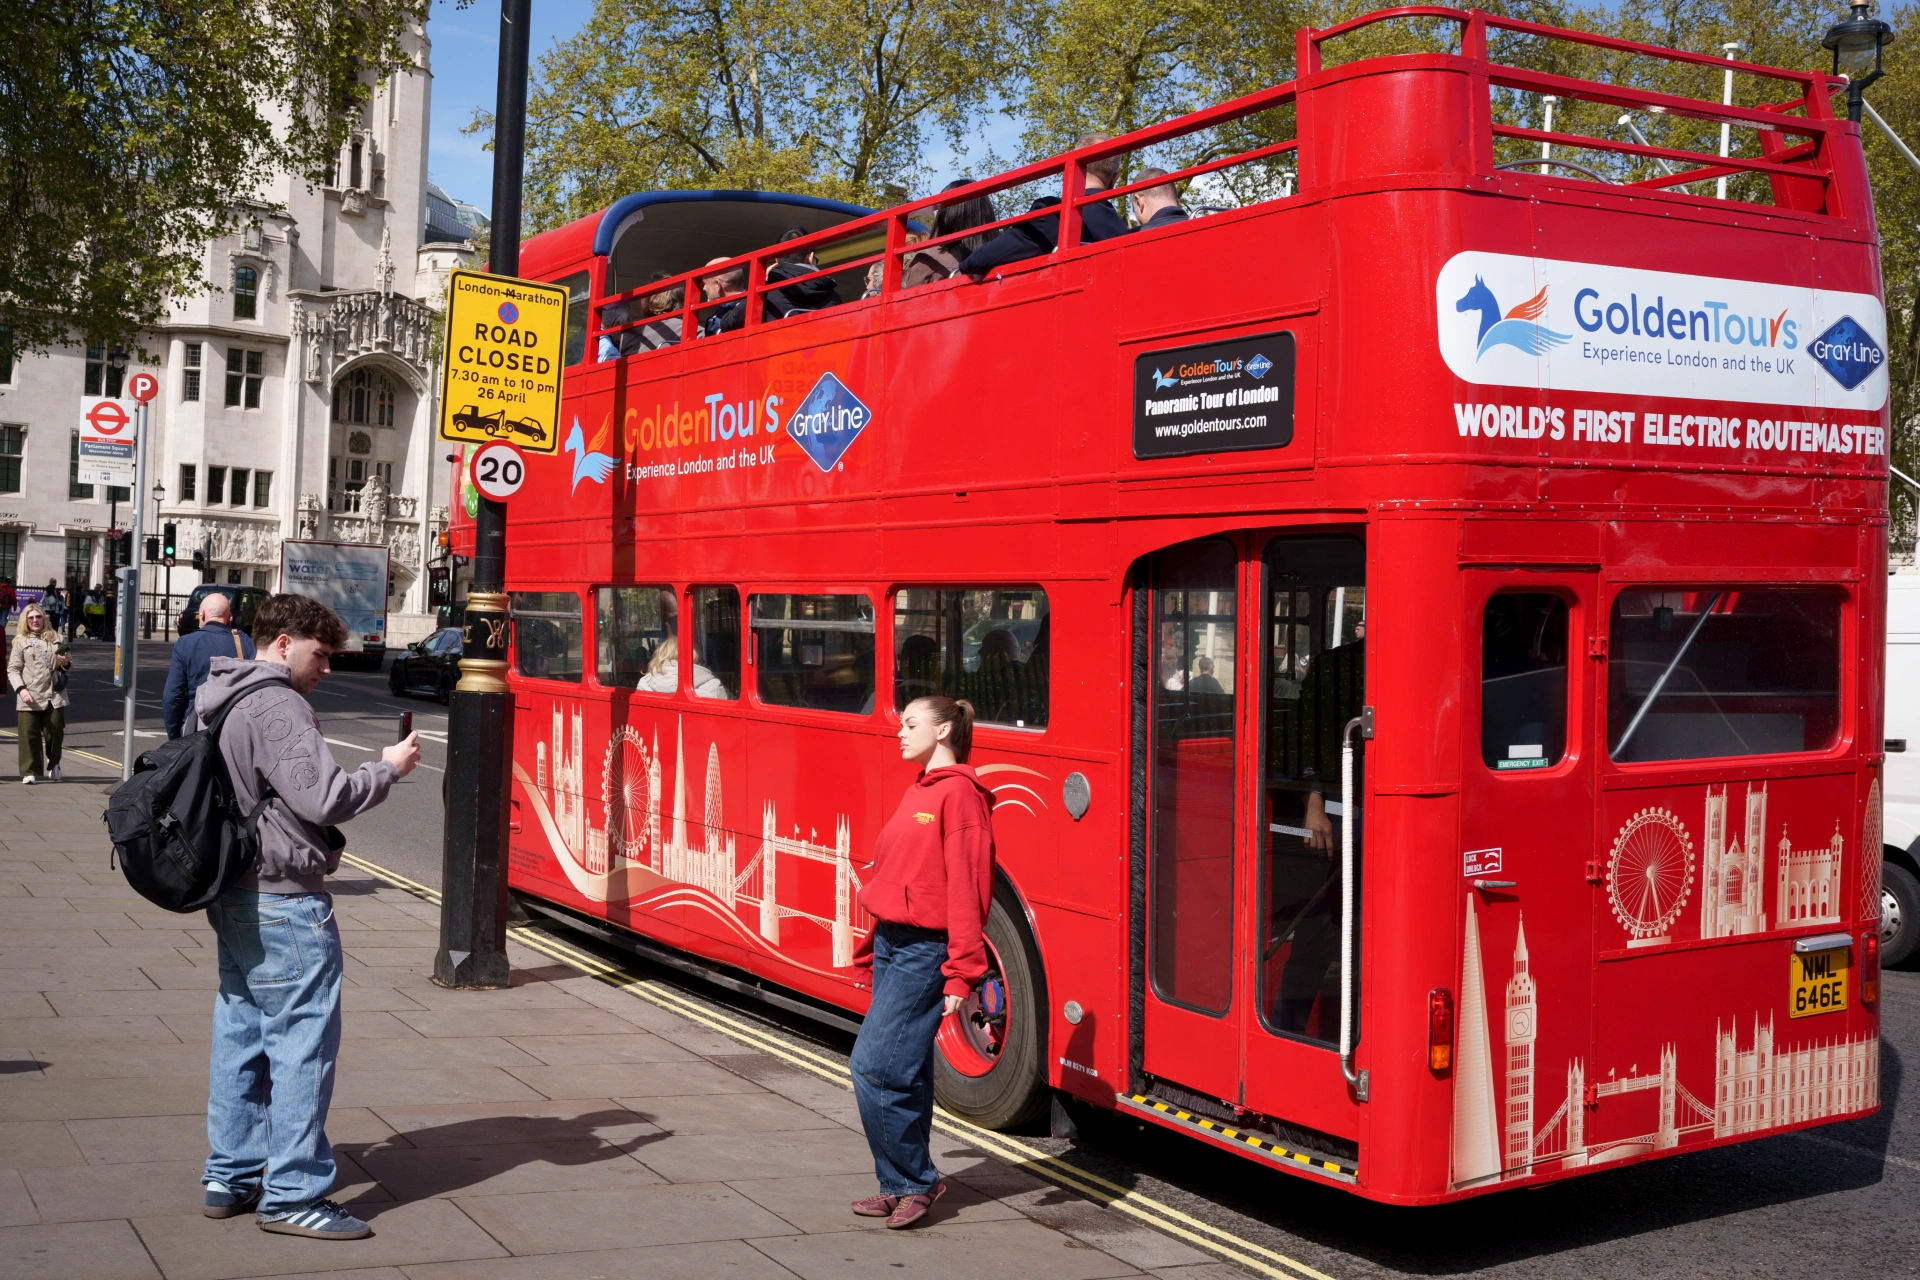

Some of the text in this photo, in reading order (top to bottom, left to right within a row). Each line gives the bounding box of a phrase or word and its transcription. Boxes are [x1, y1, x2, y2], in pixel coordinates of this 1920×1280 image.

[458, 281, 560, 306] London Marathon
[1574, 287, 1797, 349] GoldenTours
[475, 323, 537, 348] ROAD
[459, 346, 550, 374] CLOSED
[1179, 356, 1242, 378] GoldenTours
[1584, 342, 1794, 374] Experience London and the UK
[136, 378, 151, 397] P
[452, 369, 554, 393] 7.30 am to 10 pm
[1181, 377, 1202, 386] Experience
[478, 388, 525, 403] 26 April
[1146, 386, 1278, 416] Panoramic Tour of London
[624, 381, 779, 453] GoldenTours
[1155, 415, 1266, 437] www.goldentours.com
[1454, 403, 1884, 455] WORLD'S FIRST ELECTRIC ROUTEMASTER
[480, 457, 521, 485] 20
[627, 445, 775, 485] Experience London and the UK
[289, 564, 330, 574] water
[1500, 760, 1530, 768] EMERGENCY
[1466, 854, 1477, 863] LOCK
[1466, 864, 1482, 873] UNLOCK
[1803, 954, 1836, 982] NML
[1796, 981, 1842, 1011] 646E
[1086, 1066, 1098, 1077] KGS
